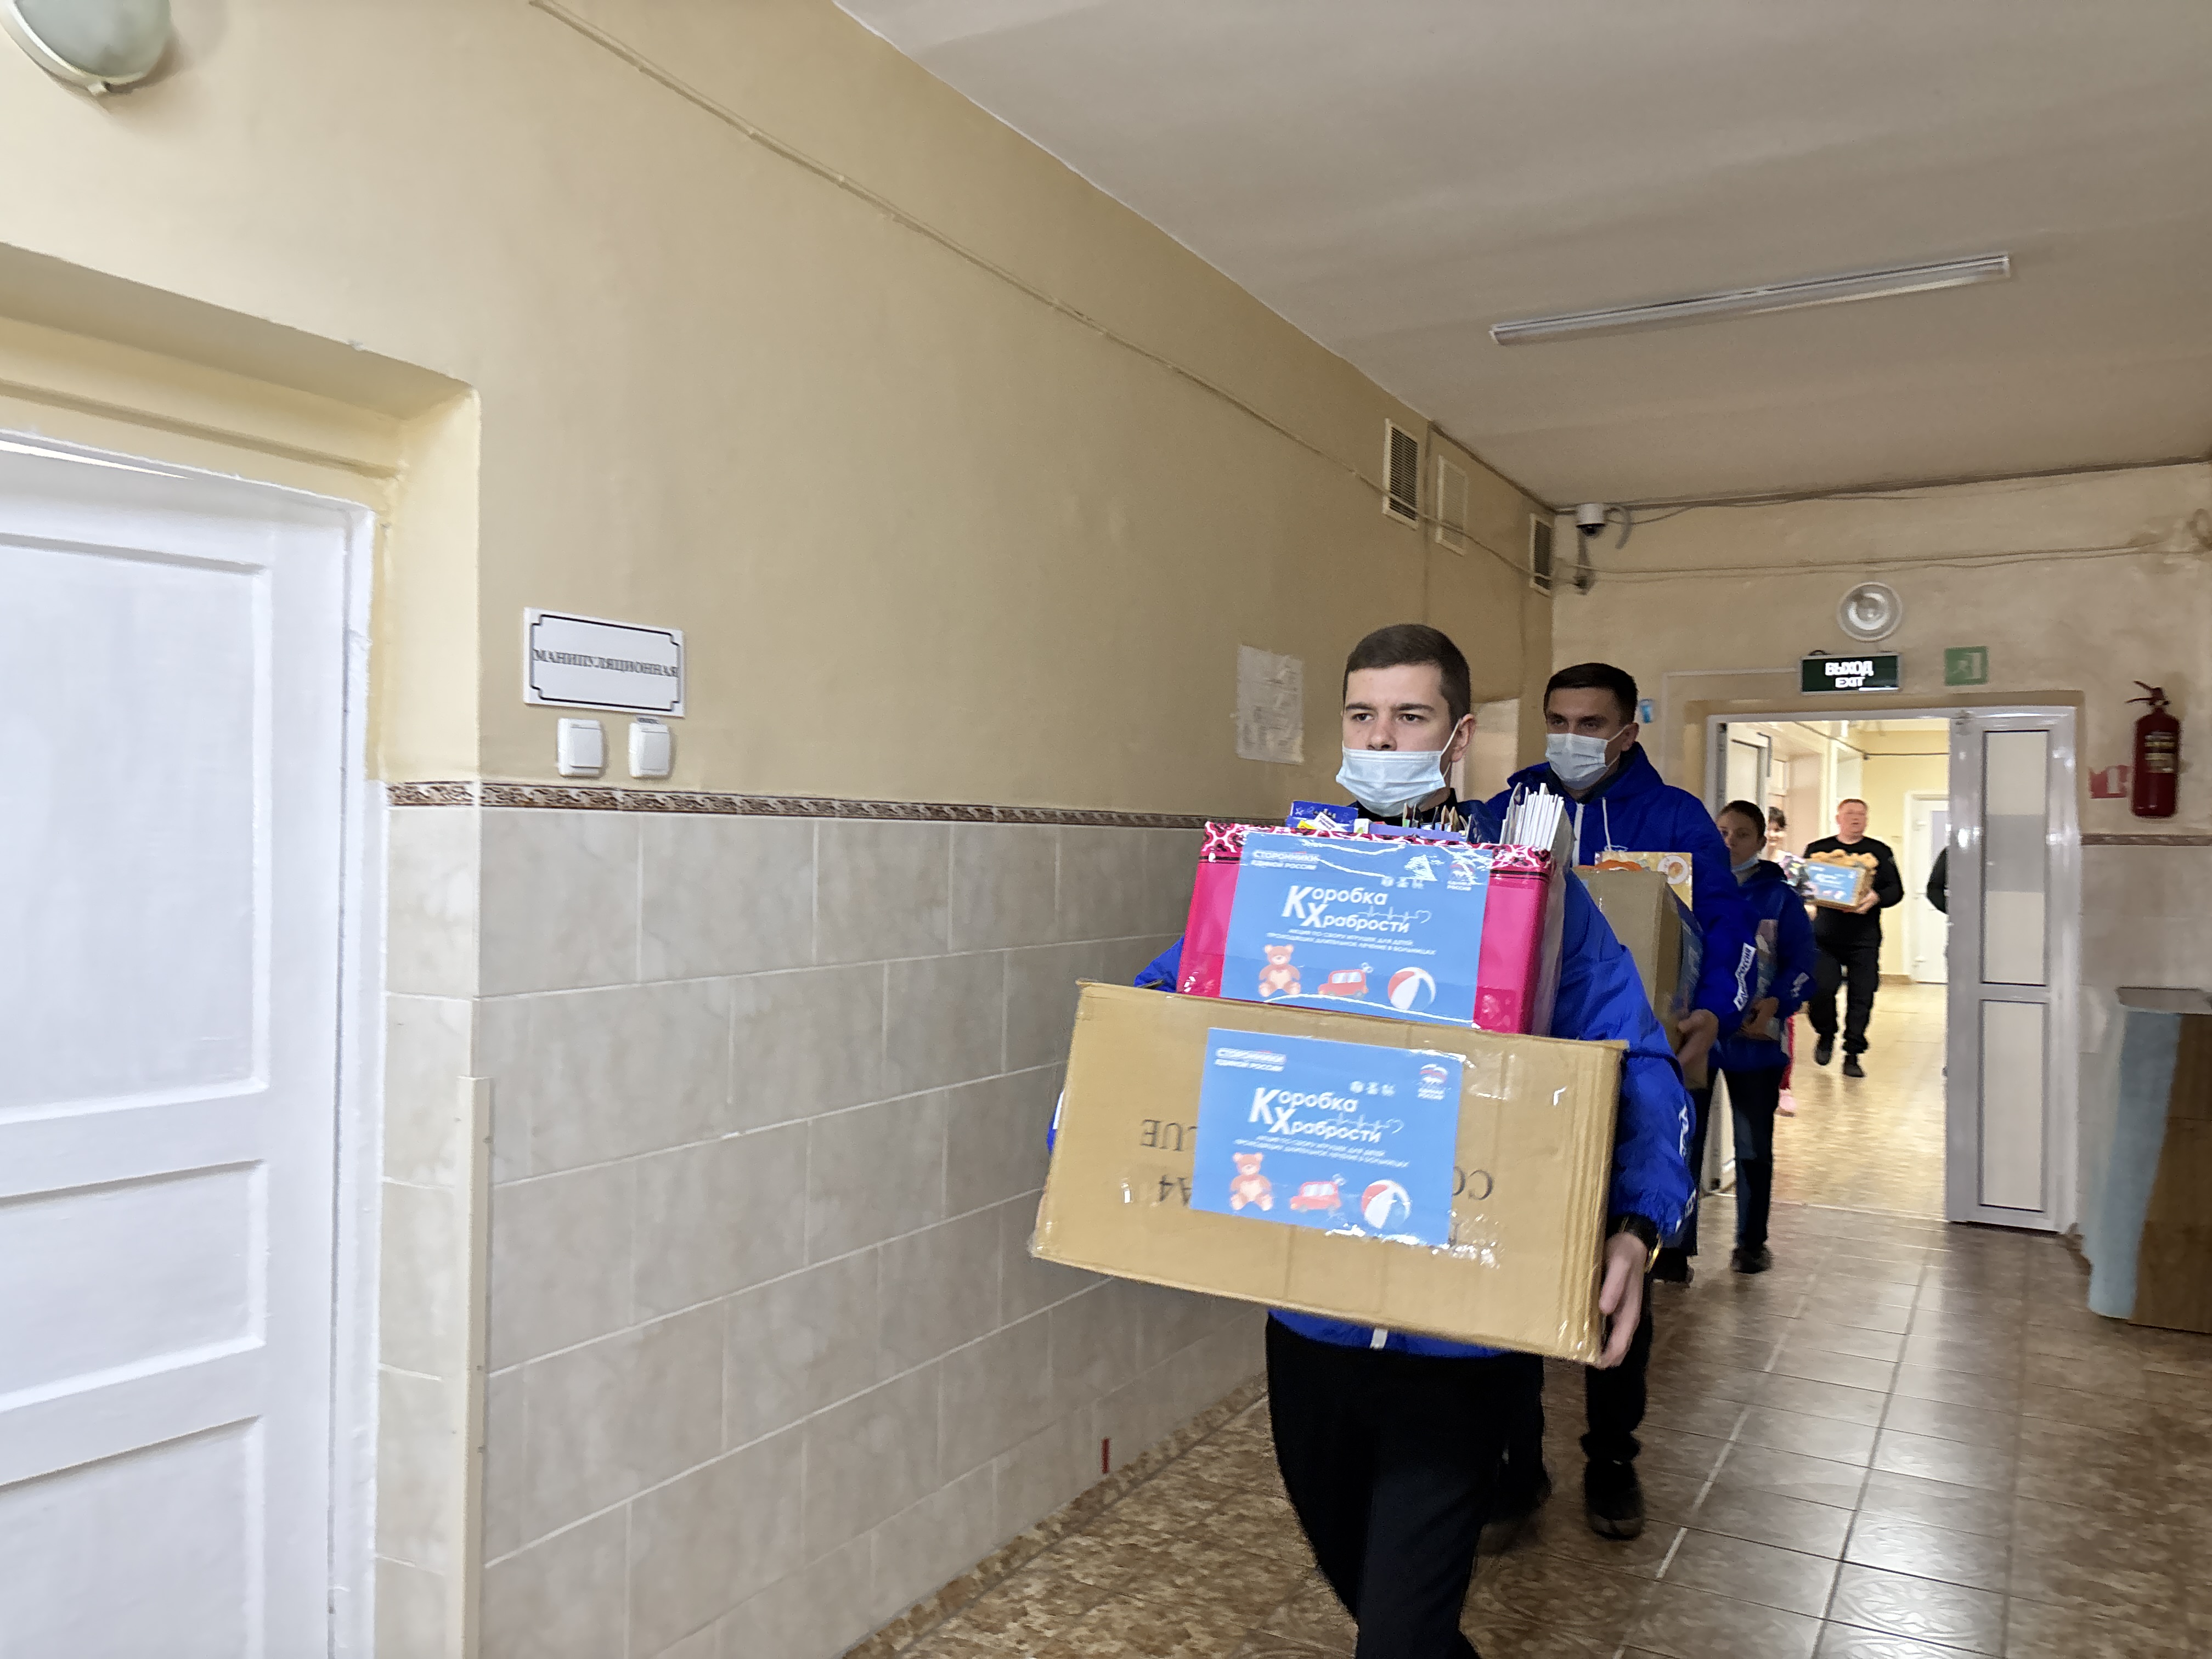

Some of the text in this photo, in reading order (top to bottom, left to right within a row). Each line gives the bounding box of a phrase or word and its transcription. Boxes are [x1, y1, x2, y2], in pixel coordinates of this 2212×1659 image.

[1825, 661, 1874, 676] ВЫХОД
[1835, 676, 1865, 688] EXIT
[1281, 885, 1389, 919] Коробка
[1300, 902, 1410, 933] Храбрости
[1248, 1087, 1359, 1125] Коробка
[1267, 1107, 1383, 1143] Храбрости
